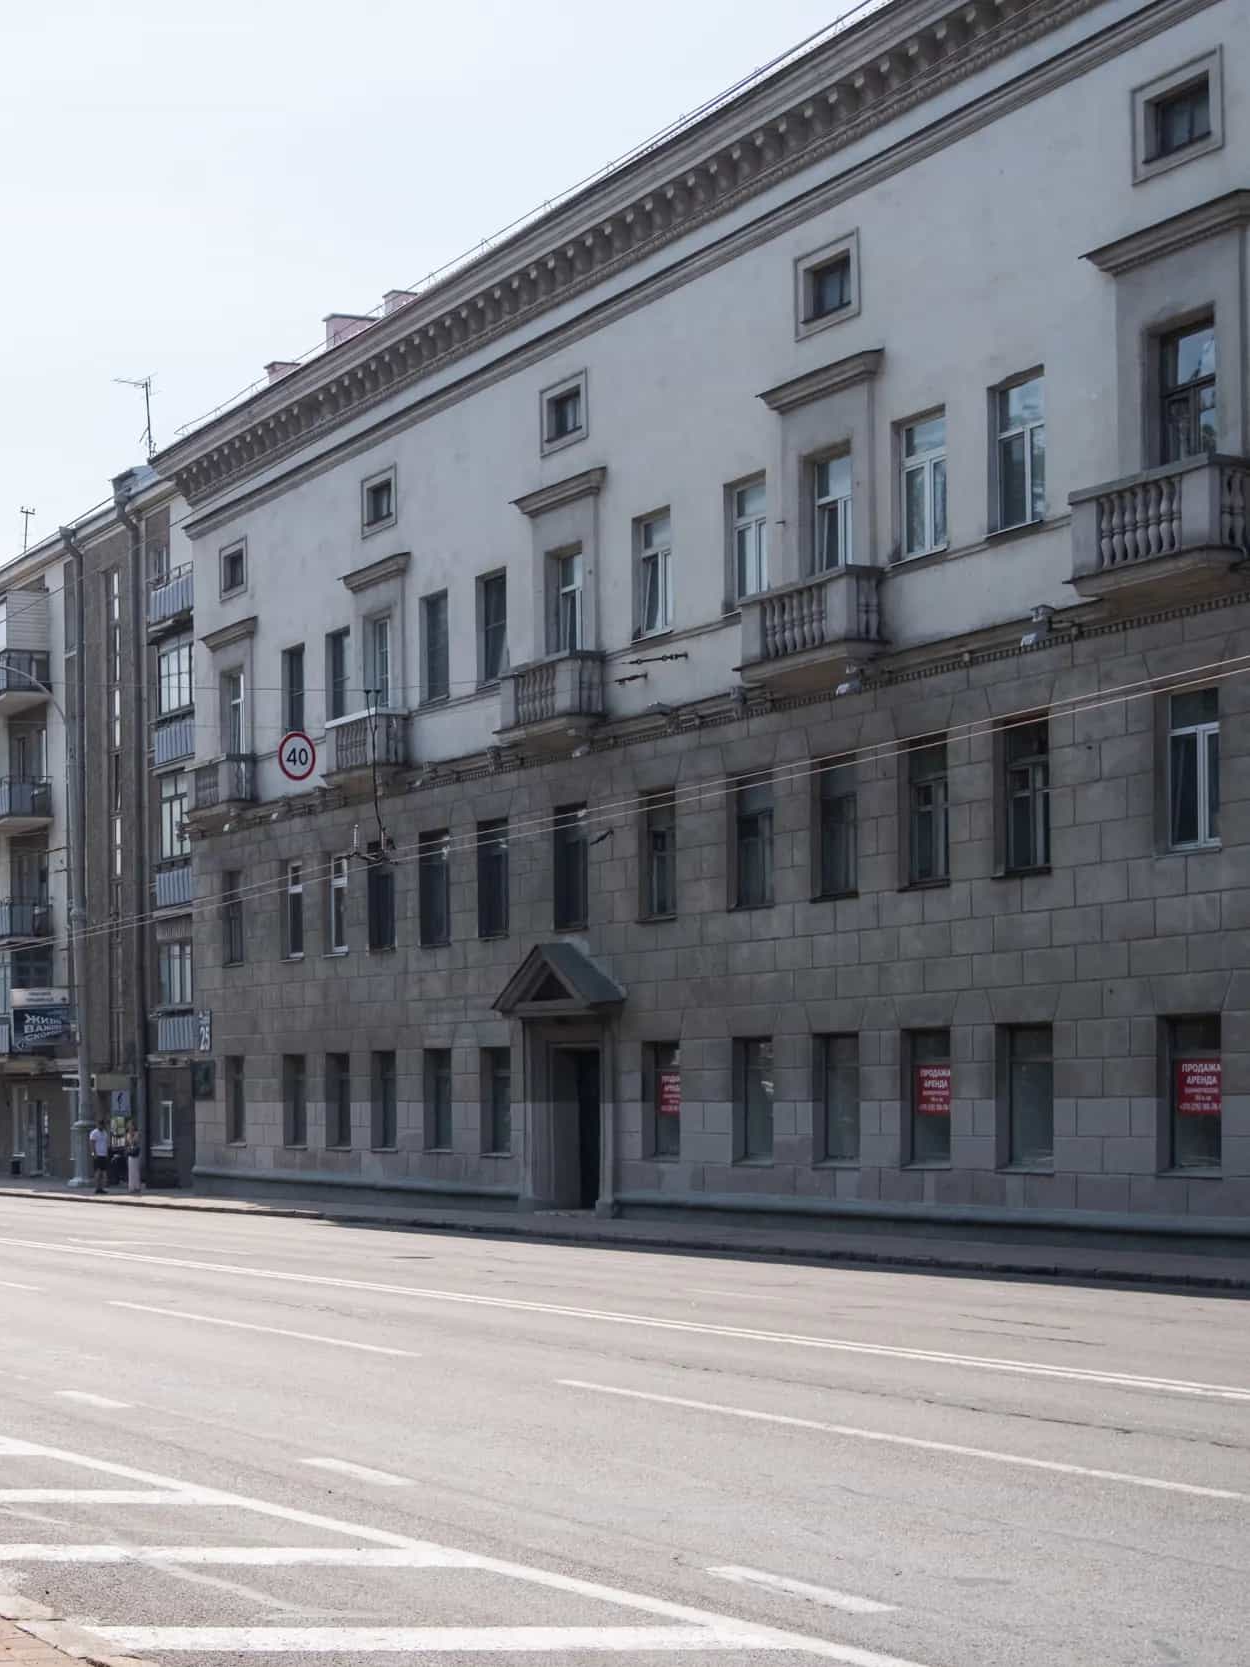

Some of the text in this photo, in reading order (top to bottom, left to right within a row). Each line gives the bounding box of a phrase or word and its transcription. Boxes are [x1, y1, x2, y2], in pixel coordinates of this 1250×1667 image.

[286, 747, 308, 766] 40
[199, 1026, 210, 1050] 25
[1181, 1063, 1221, 1073] ПРОДАЖА
[924, 1079, 948, 1088] АРЕНДА
[1186, 1075, 1218, 1085] АРЕНДА
